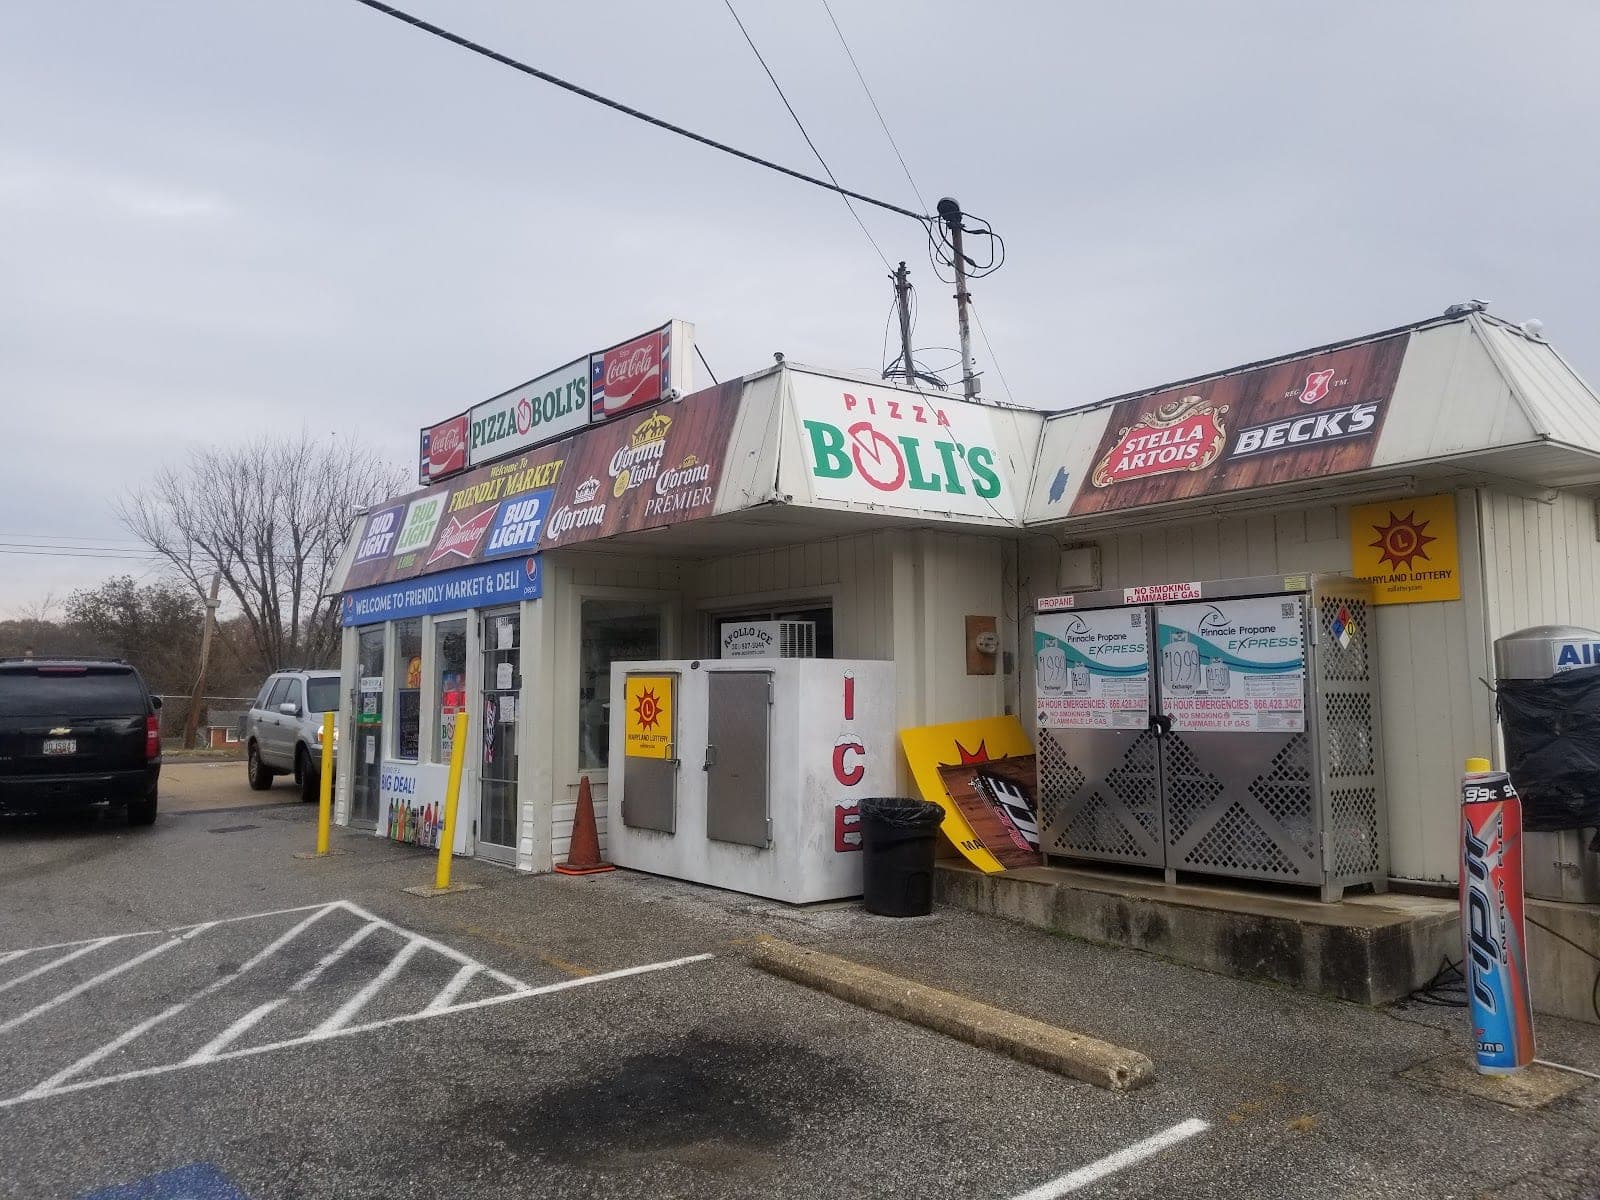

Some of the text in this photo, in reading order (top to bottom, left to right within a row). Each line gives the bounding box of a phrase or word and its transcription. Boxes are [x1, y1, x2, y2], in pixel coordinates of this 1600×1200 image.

[606, 345, 652, 385] Coca-Cola
[472, 376, 587, 449] PIZZA BOLI'S
[844, 393, 950, 427] PIZZA
[1122, 425, 1203, 454] STELLA
[1233, 405, 1377, 455] BECK'S
[609, 439, 666, 478] Corona
[803, 420, 1000, 498] BOLI'S
[1114, 442, 1200, 472] ARTOIS
[448, 460, 564, 513] FRIENDLY MARKET
[628, 460, 660, 489] Light
[656, 463, 709, 495] Corona
[410, 501, 437, 522] BUD
[503, 499, 540, 526] BUD
[644, 487, 713, 516] PREMIER
[368, 513, 394, 537] BUD
[398, 521, 438, 549] LIGHT
[489, 520, 540, 550] LIGHT
[547, 503, 606, 541] Corona
[358, 533, 394, 559] LIGHT
[1134, 583, 1190, 595] NO SMOKING
[1411, 570, 1452, 582] LOTTERY
[356, 570, 519, 616] WELCOME TO FRIENDLY MARKET & DELI
[1040, 597, 1073, 608] PROPANE
[1126, 590, 1200, 602] FLAMMABLE GAS
[724, 628, 773, 648] APOLLO ICE
[1067, 632, 1127, 643] Pinnacle Propane
[1201, 626, 1276, 636] Pinnacle Propane
[1228, 637, 1298, 652] EXPRESS
[1089, 644, 1145, 657] EXPRESS
[1038, 700, 1044, 708] 24
[1045, 700, 1062, 708] HOUR
[1164, 701, 1172, 710] 24
[1173, 700, 1194, 710] HOUR
[650, 735, 668, 743] LOTTERY
[833, 670, 866, 852] ICE
[394, 776, 416, 794] DEAL!
[1498, 877, 1508, 966] ENERGY
